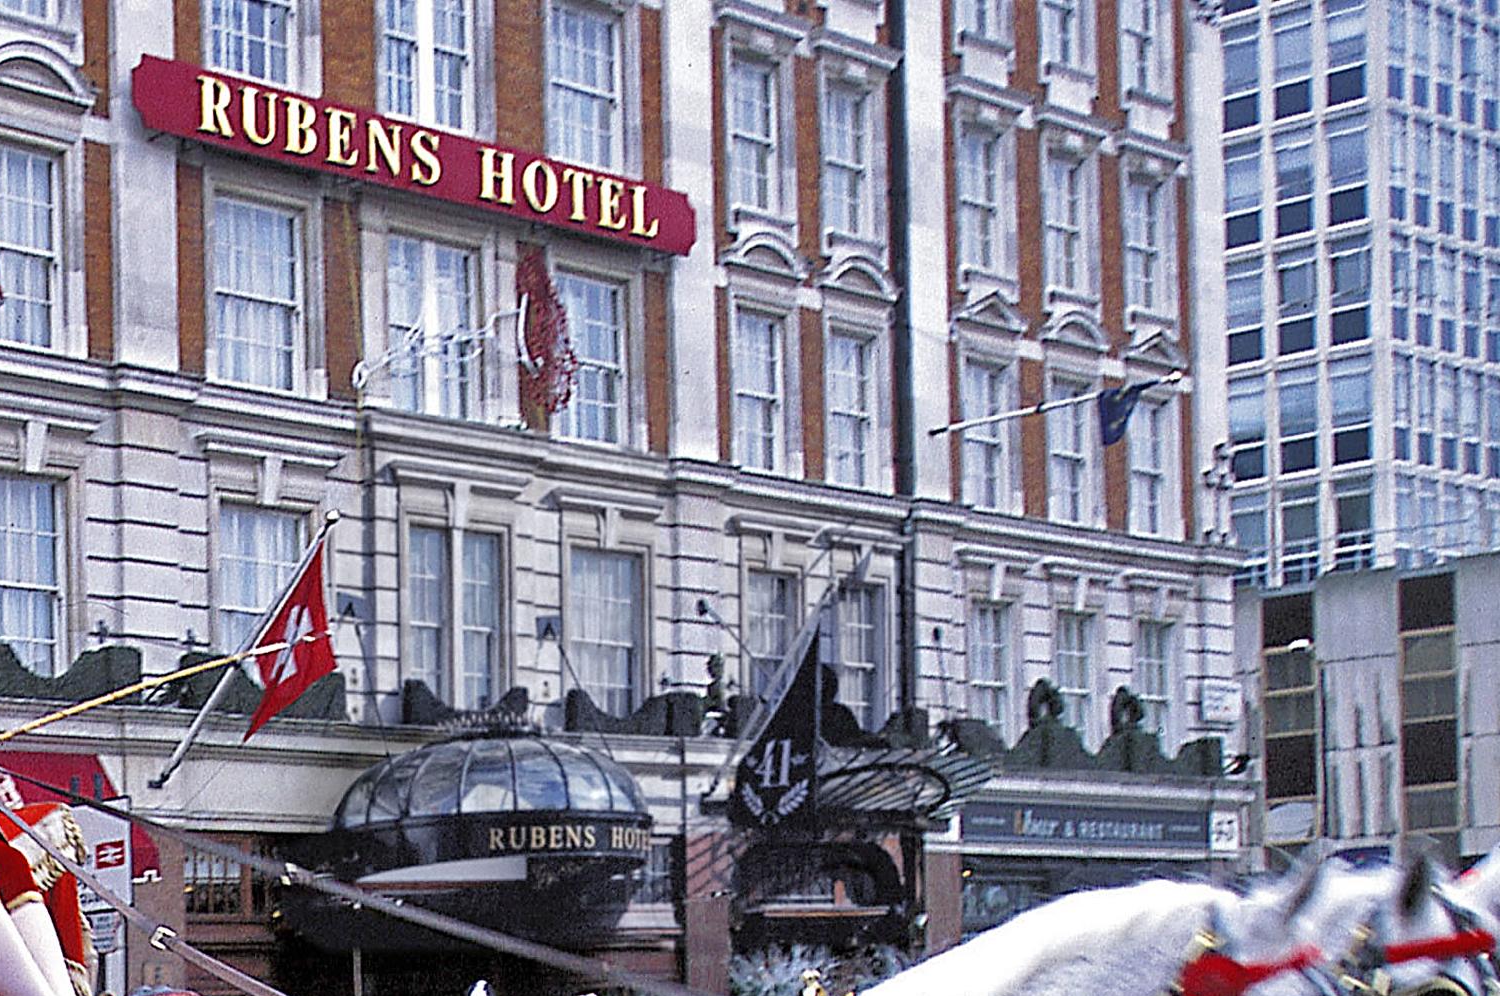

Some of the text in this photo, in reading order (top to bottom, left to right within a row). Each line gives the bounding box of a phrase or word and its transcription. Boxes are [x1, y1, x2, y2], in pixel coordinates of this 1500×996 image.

[197, 75, 661, 239] RUBENS HOTEL
[755, 739, 792, 788] 41
[489, 824, 597, 851] RUBENS
